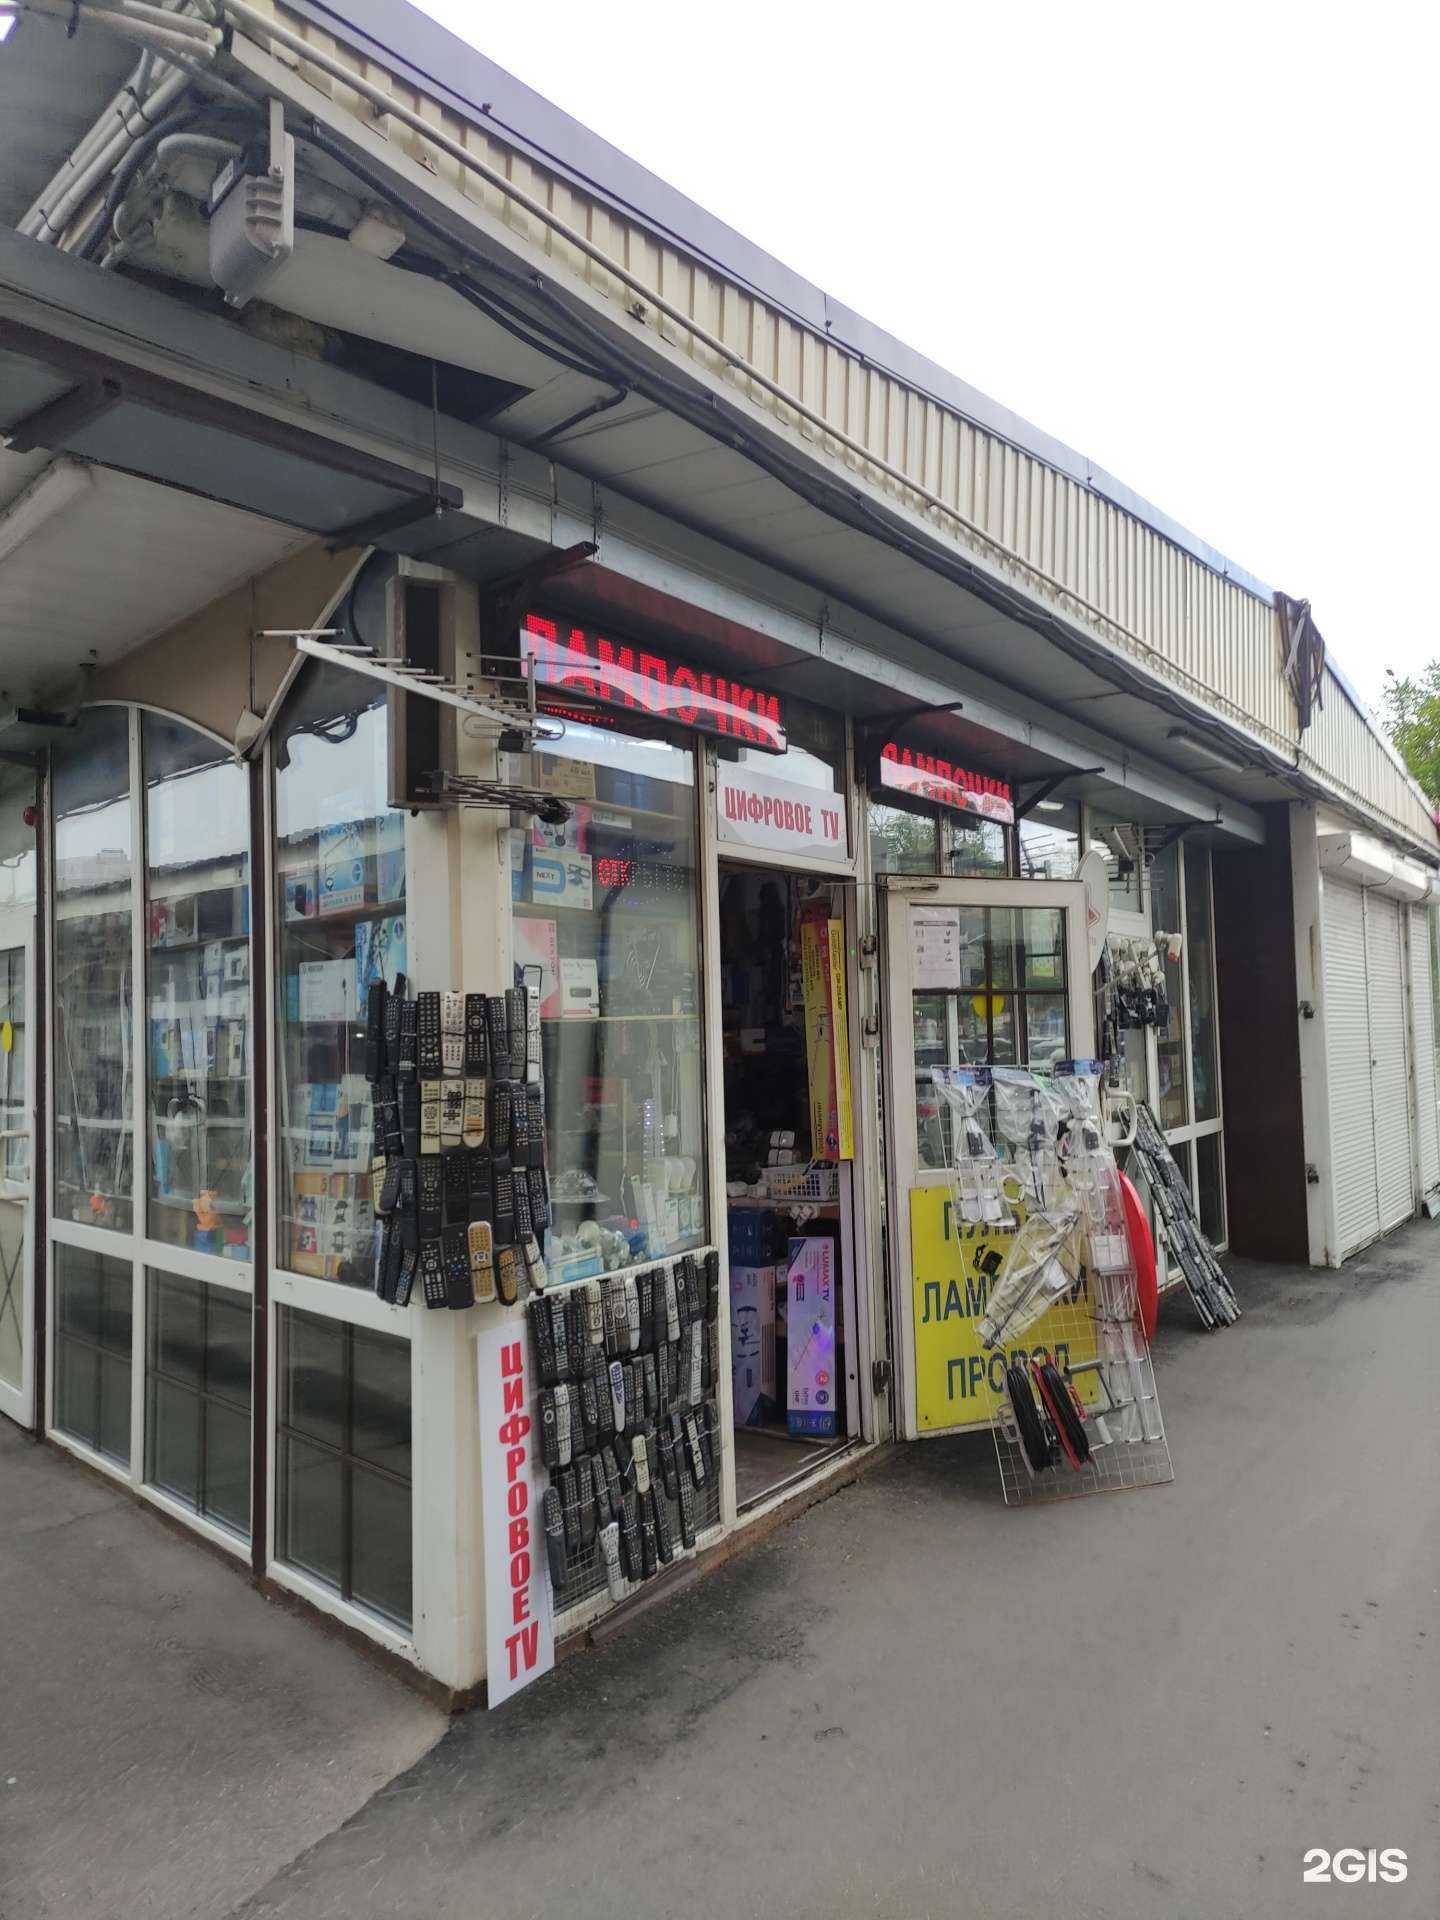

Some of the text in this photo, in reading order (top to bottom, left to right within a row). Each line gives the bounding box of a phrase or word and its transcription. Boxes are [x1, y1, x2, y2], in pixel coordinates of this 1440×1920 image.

[521, 613, 783, 749] ЛАМПОЧКИ
[724, 786, 840, 841] ЦИФРОВОЕ TV
[822, 1250, 830, 1302] LUMAX TV
[498, 1341, 540, 1682] ЦИФРОВОЕ TV
